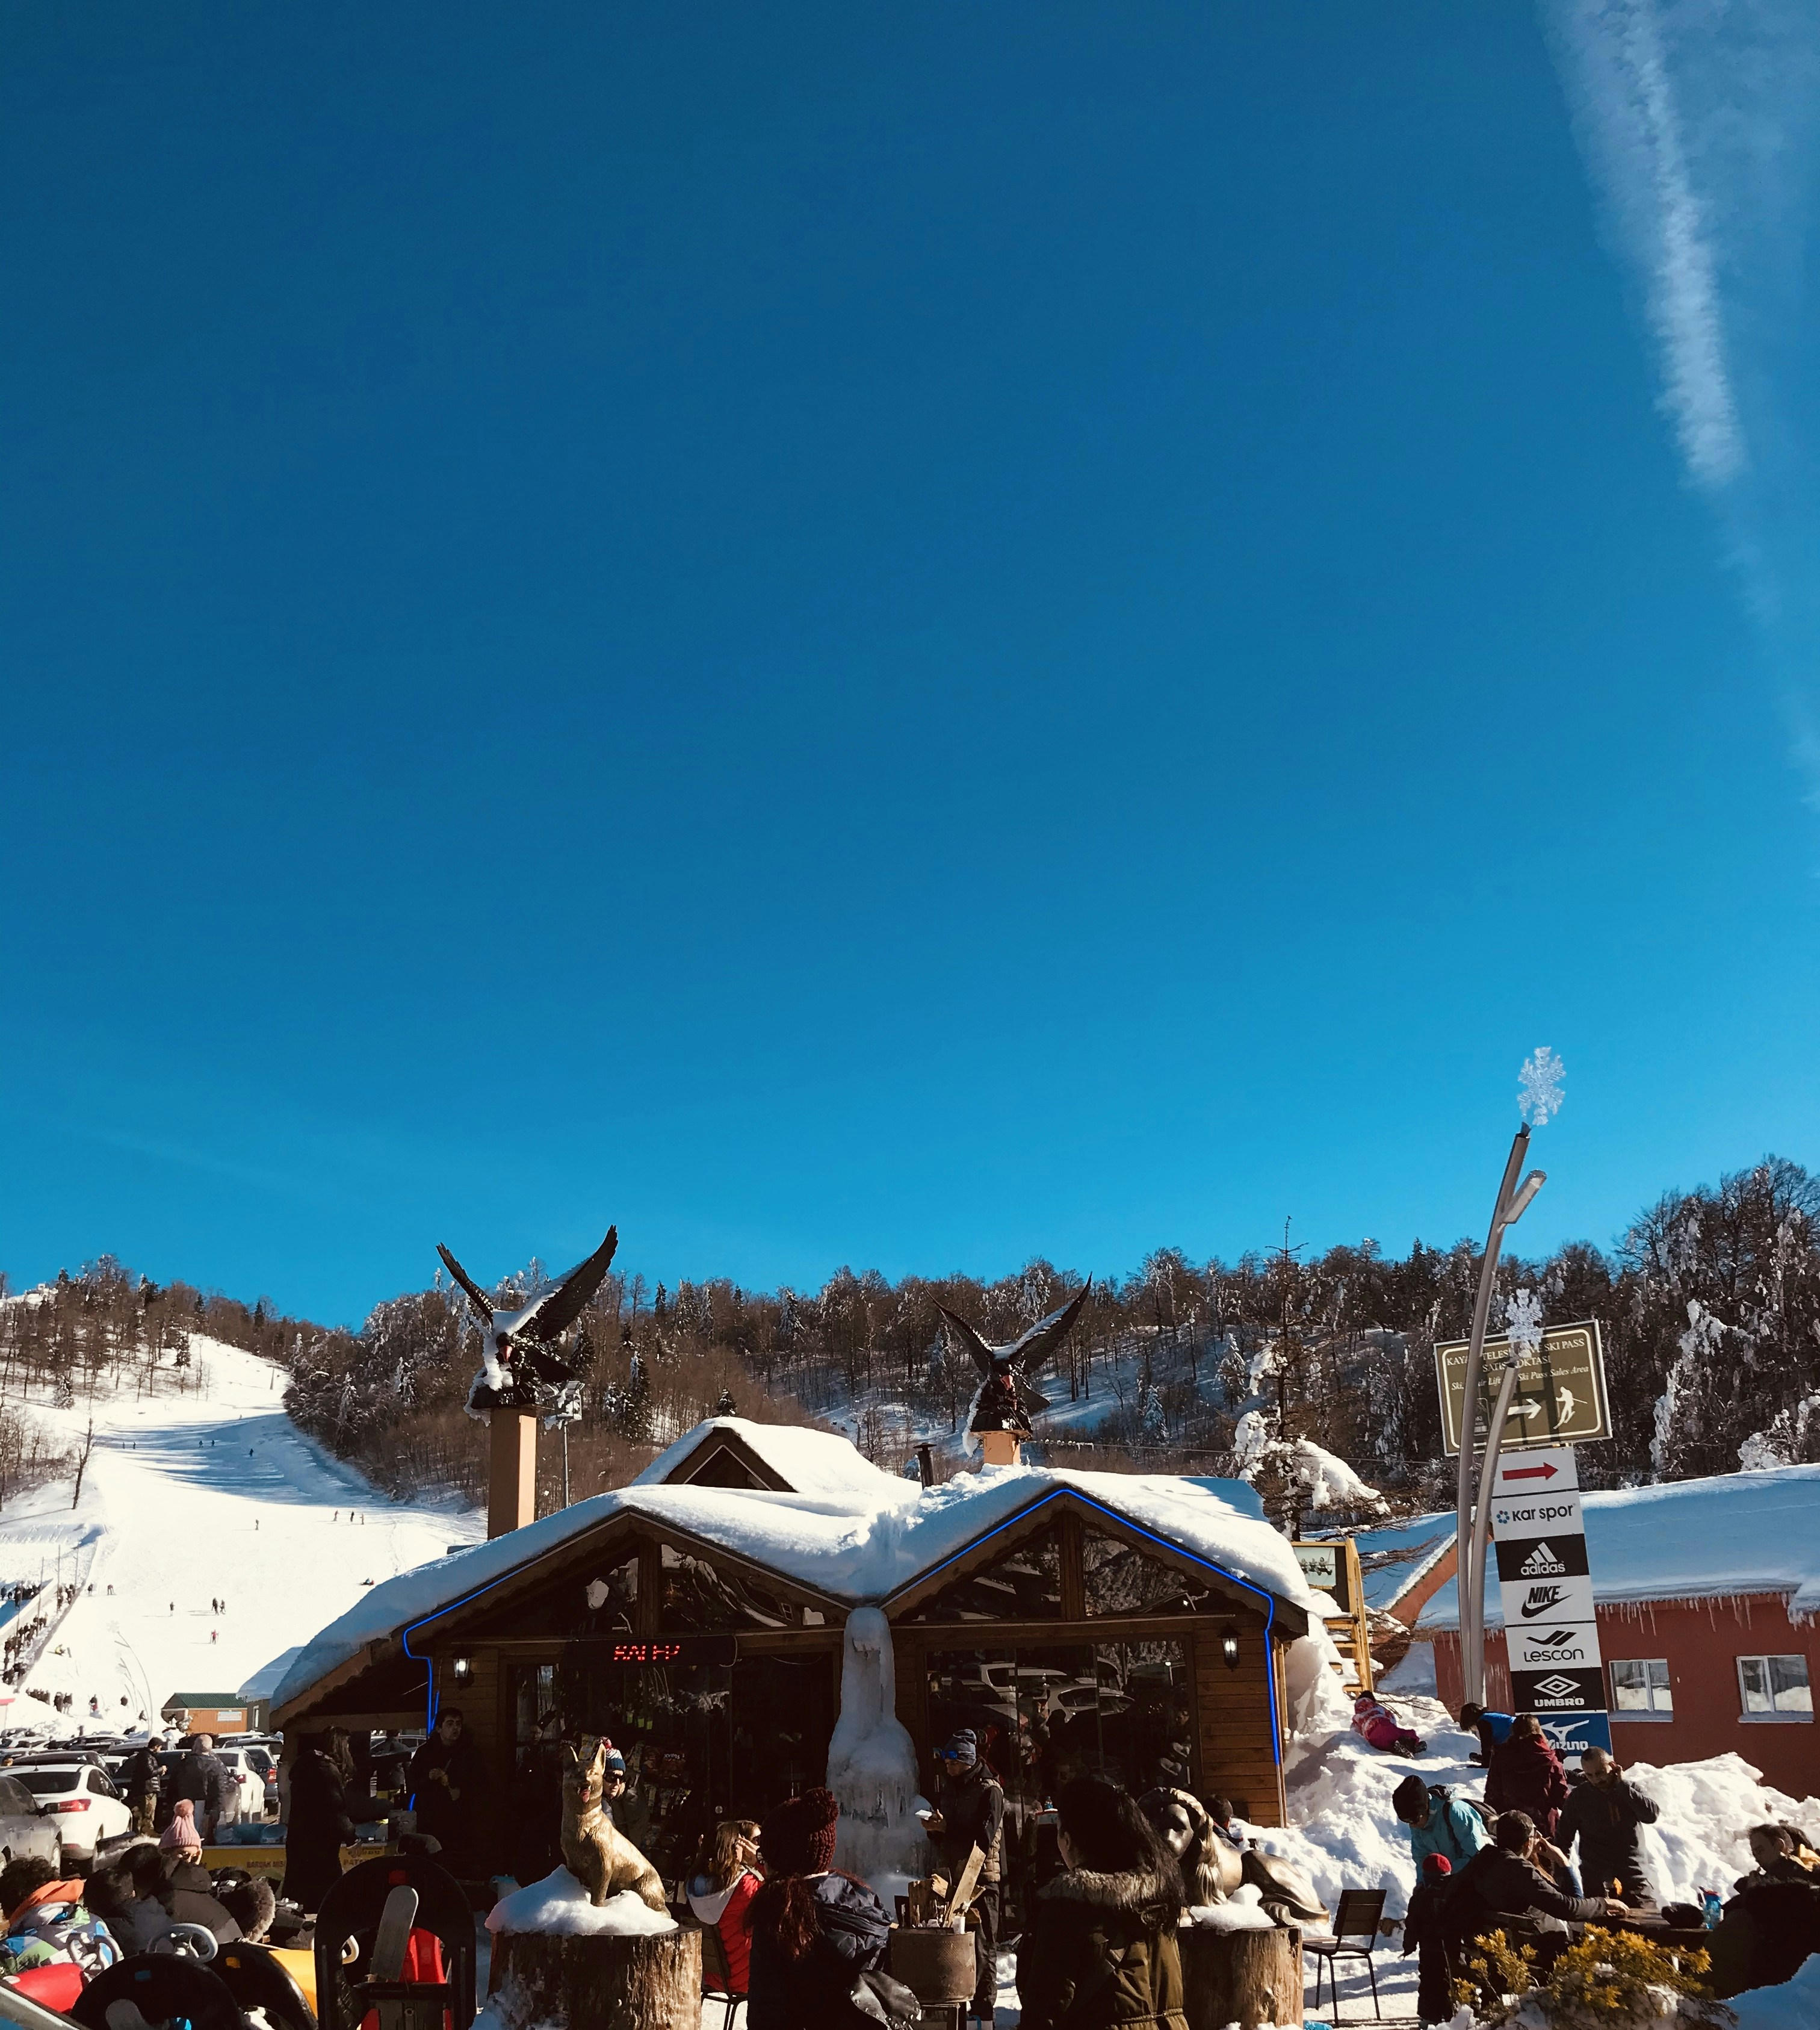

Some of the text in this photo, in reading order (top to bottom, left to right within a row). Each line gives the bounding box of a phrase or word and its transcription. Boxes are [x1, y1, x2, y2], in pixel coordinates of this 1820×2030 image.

[1544, 1342, 1561, 1352] SKI
[1562, 1338, 1585, 1349] PASS
[1514, 1355, 1552, 1369] OKTASI
[1488, 1376, 1502, 1386] Lift
[1517, 1373, 1529, 1382] Ski
[1531, 1371, 1547, 1380] Pass
[1550, 1367, 1570, 1377] Sales
[1570, 1366, 1589, 1374] Area
[1539, 1504, 1574, 1522] spor
[1520, 1562, 1565, 1575] adidas
[1528, 1585, 1561, 1604] NIKE
[1534, 1697, 1585, 1707] UMBRO
